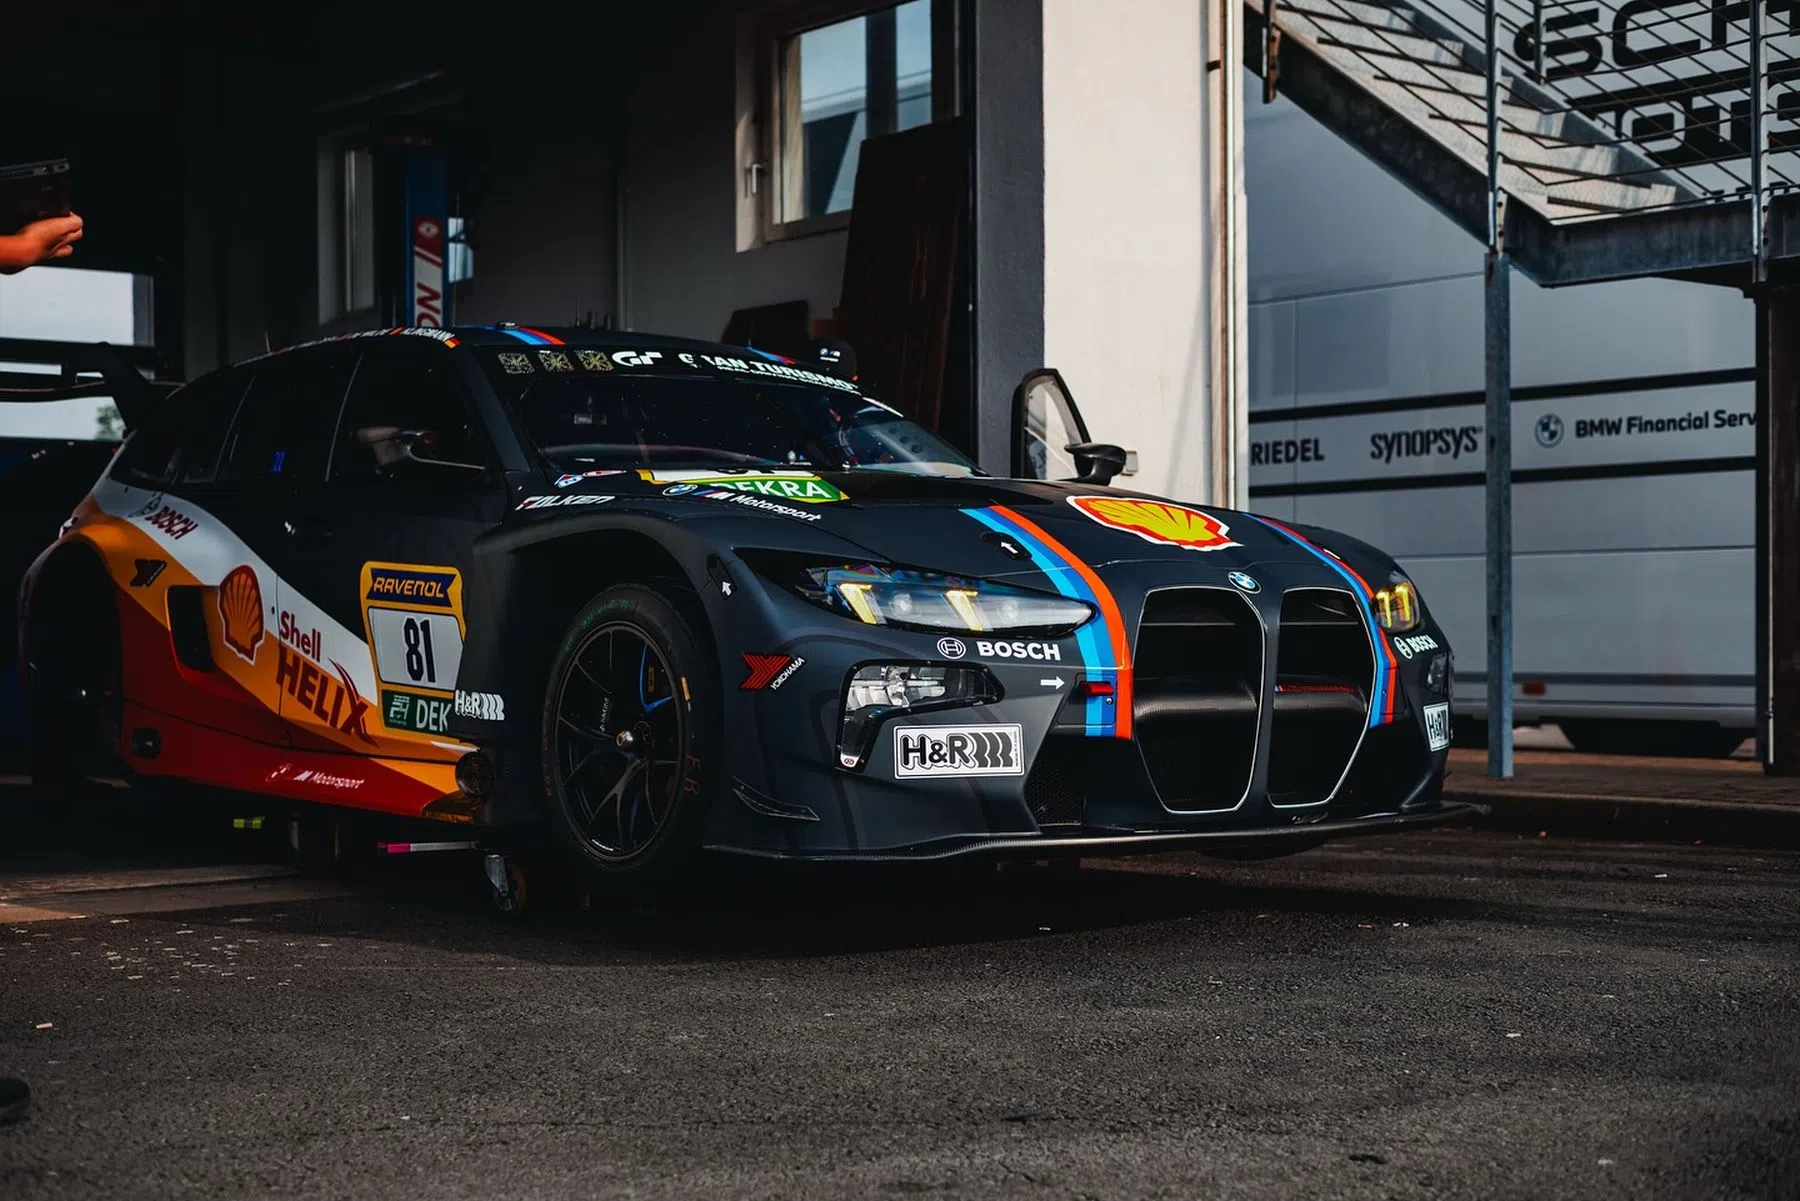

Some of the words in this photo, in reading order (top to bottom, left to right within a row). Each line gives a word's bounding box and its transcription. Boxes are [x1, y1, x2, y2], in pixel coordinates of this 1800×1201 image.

[1575, 418, 1623, 438] BMW
[1626, 411, 1709, 434] Financial
[1714, 409, 1757, 429] Serv
[1251, 438, 1325, 466] RIEDEL
[1370, 425, 1480, 464] SYNOPSYS
[145, 505, 199, 540] BOSCH
[730, 493, 823, 522] Motorsport
[373, 576, 446, 599] RAVENOL
[280, 610, 321, 662] Shell
[403, 618, 436, 683] 81
[976, 640, 1062, 661] BOSCH
[1406, 634, 1439, 653] BOSCH
[276, 644, 374, 744] HELIX
[900, 733, 979, 769] H&R
